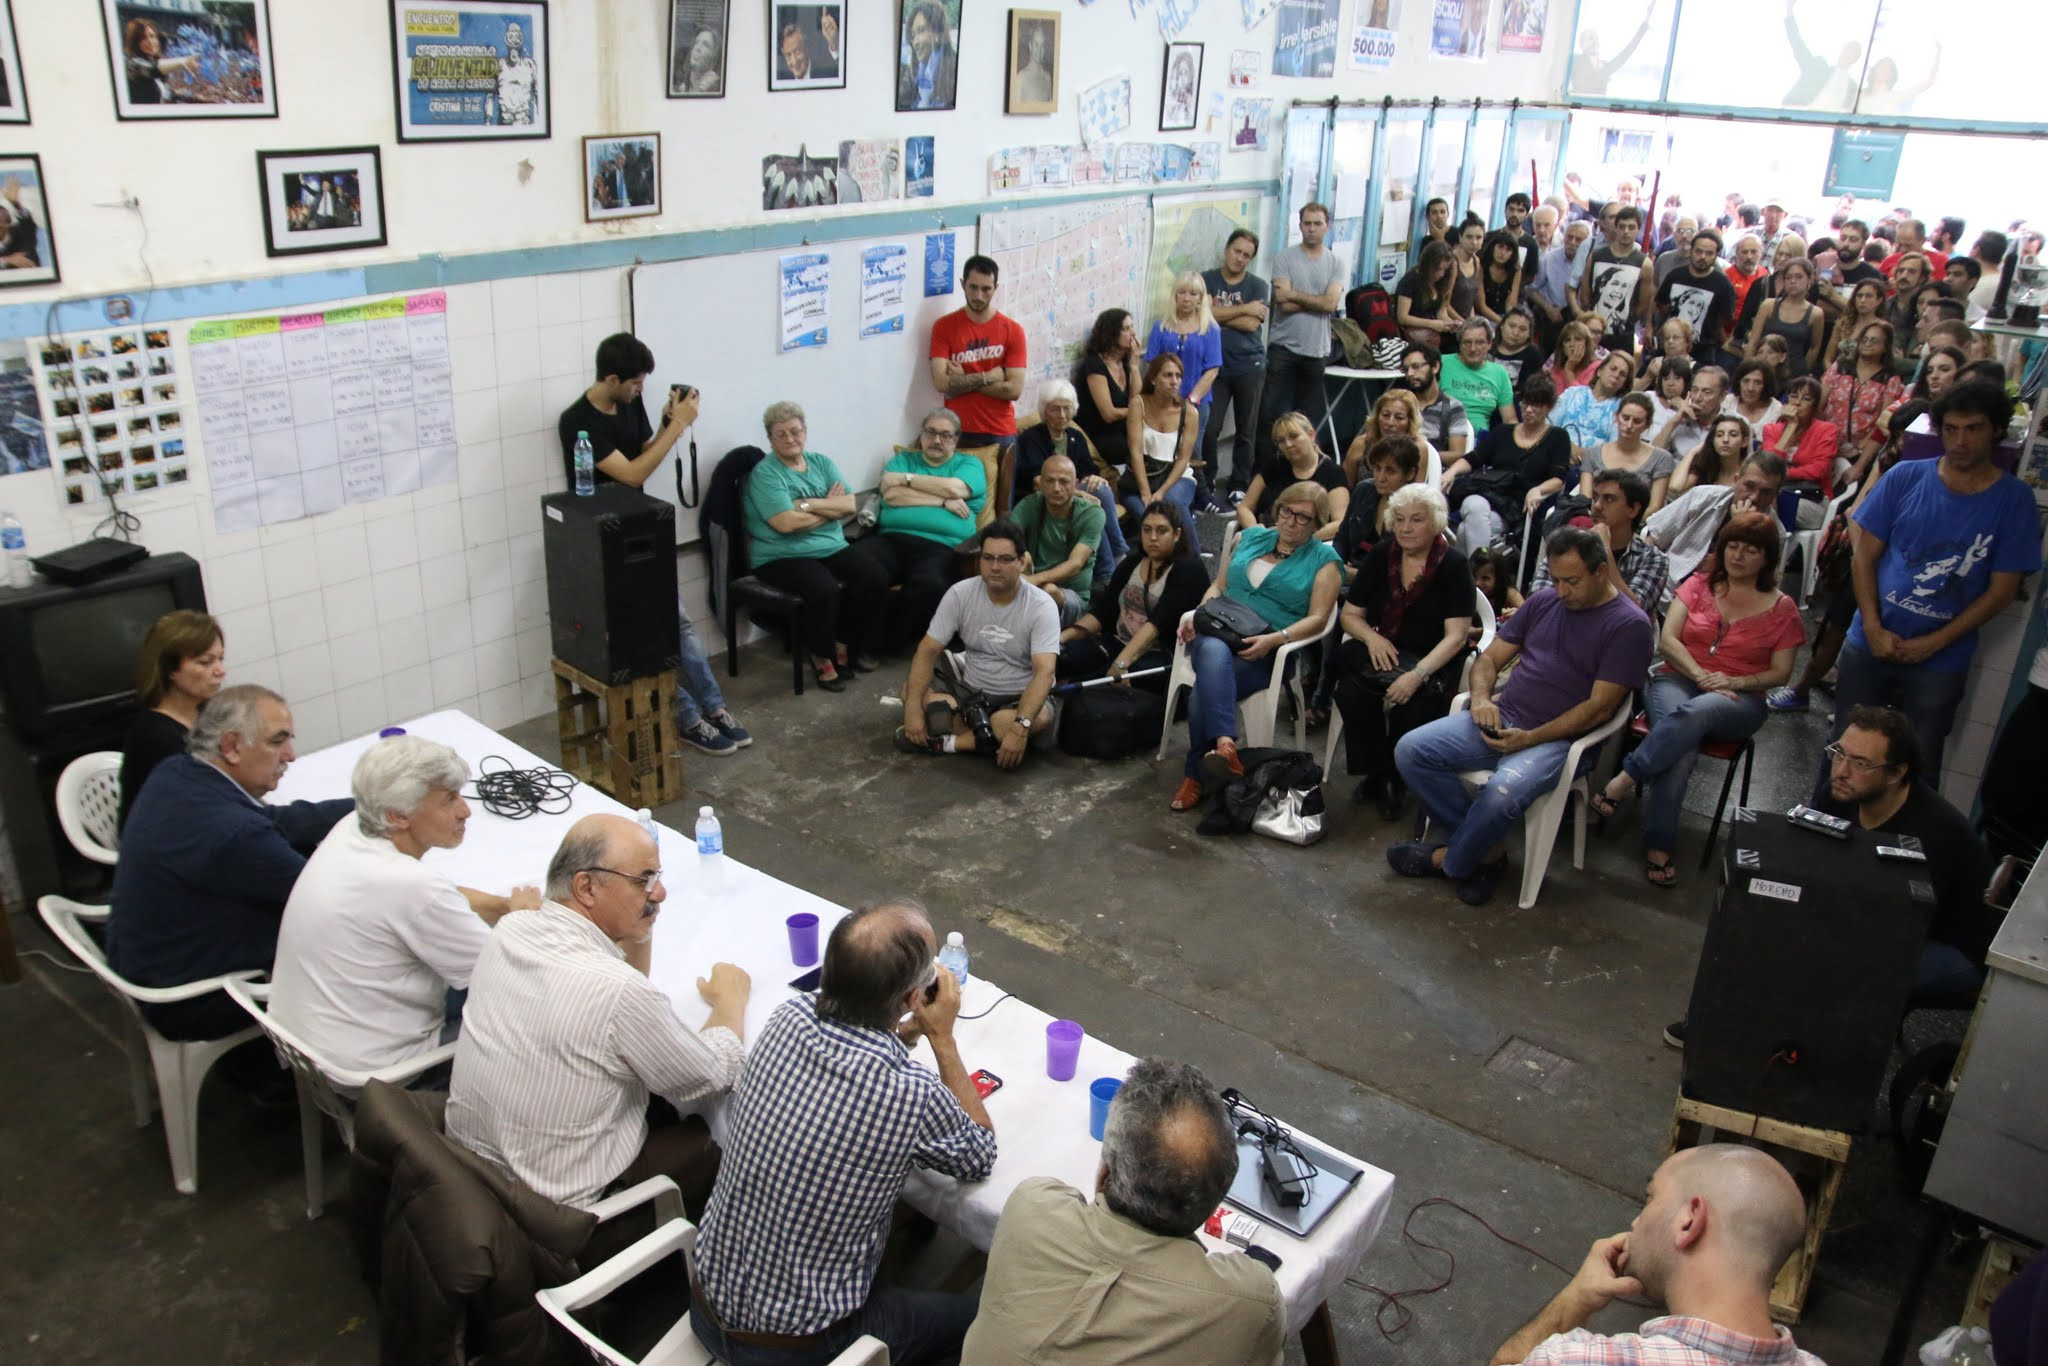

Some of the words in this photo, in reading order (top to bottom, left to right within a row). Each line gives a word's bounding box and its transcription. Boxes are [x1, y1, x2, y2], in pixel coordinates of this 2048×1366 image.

[407, 13, 455, 25] ENCUENTRO
[1353, 38, 1395, 57] 500.000
[412, 57, 430, 78] LA
[431, 57, 498, 78] JUVENTUD
[429, 103, 460, 112] CRISTINA
[190, 326, 226, 341] LUNES
[236, 319, 276, 334] MARTES
[326, 308, 361, 322] JUEVES
[367, 303, 404, 317] VIERNES
[951, 344, 1004, 363] LORENZO
[1755, 881, 1796, 898] MORENO
